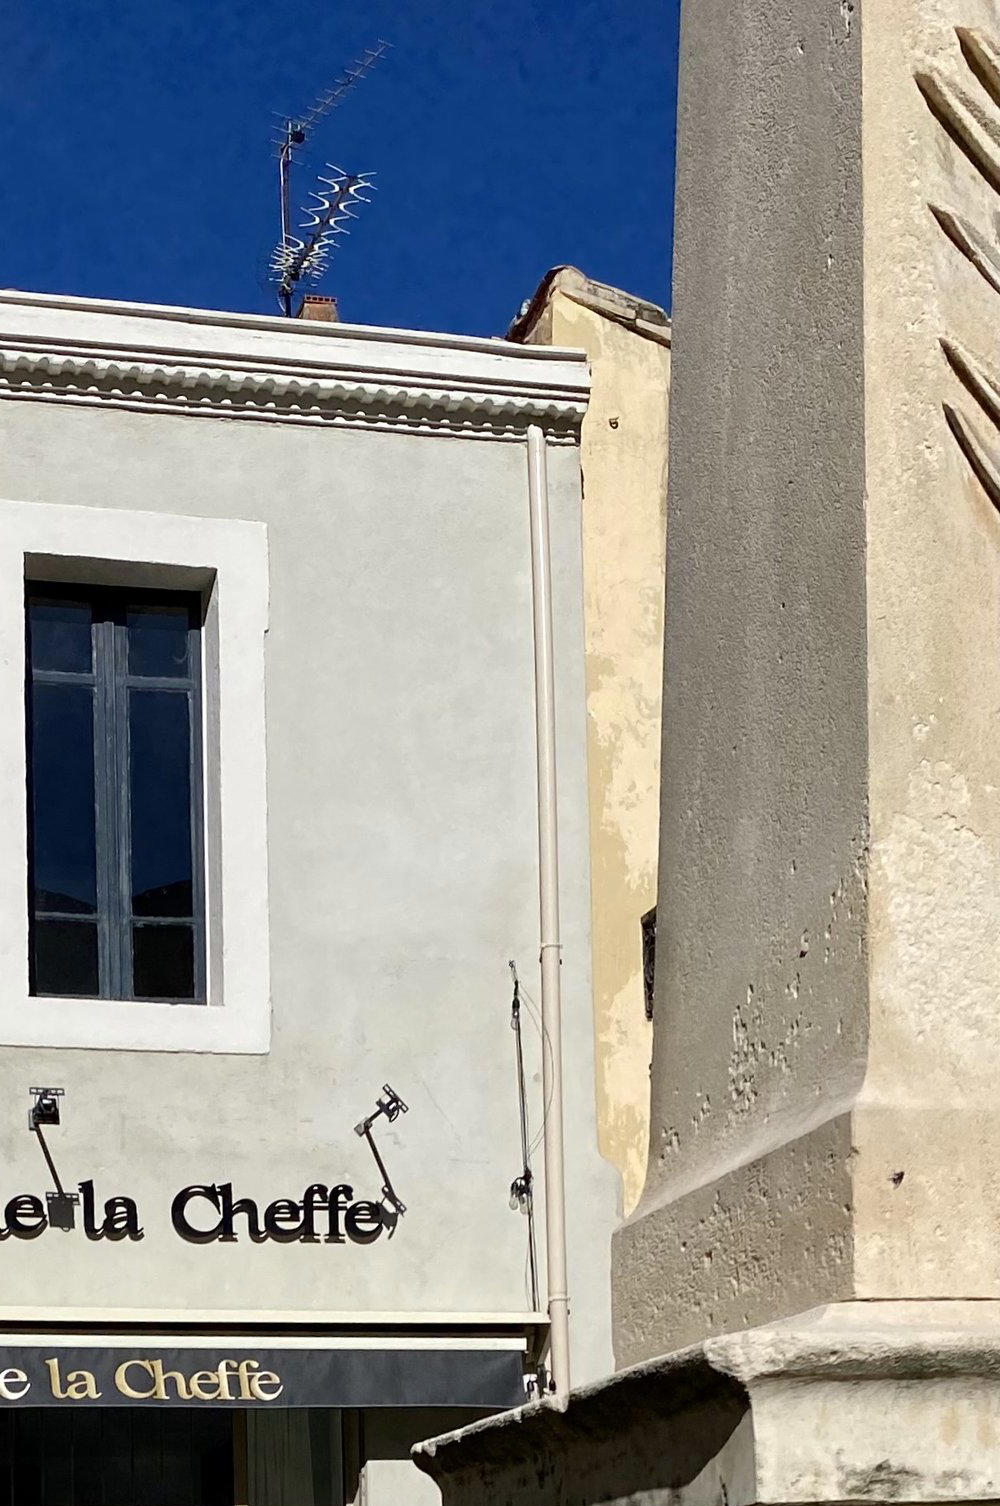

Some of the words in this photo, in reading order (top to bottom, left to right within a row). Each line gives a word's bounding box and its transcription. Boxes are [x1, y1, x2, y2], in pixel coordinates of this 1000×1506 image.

[78, 1180, 145, 1242] la
[171, 1182, 383, 1245] Cheffe
[45, 1358, 102, 1400] la
[114, 1358, 284, 1402] Cheffe
